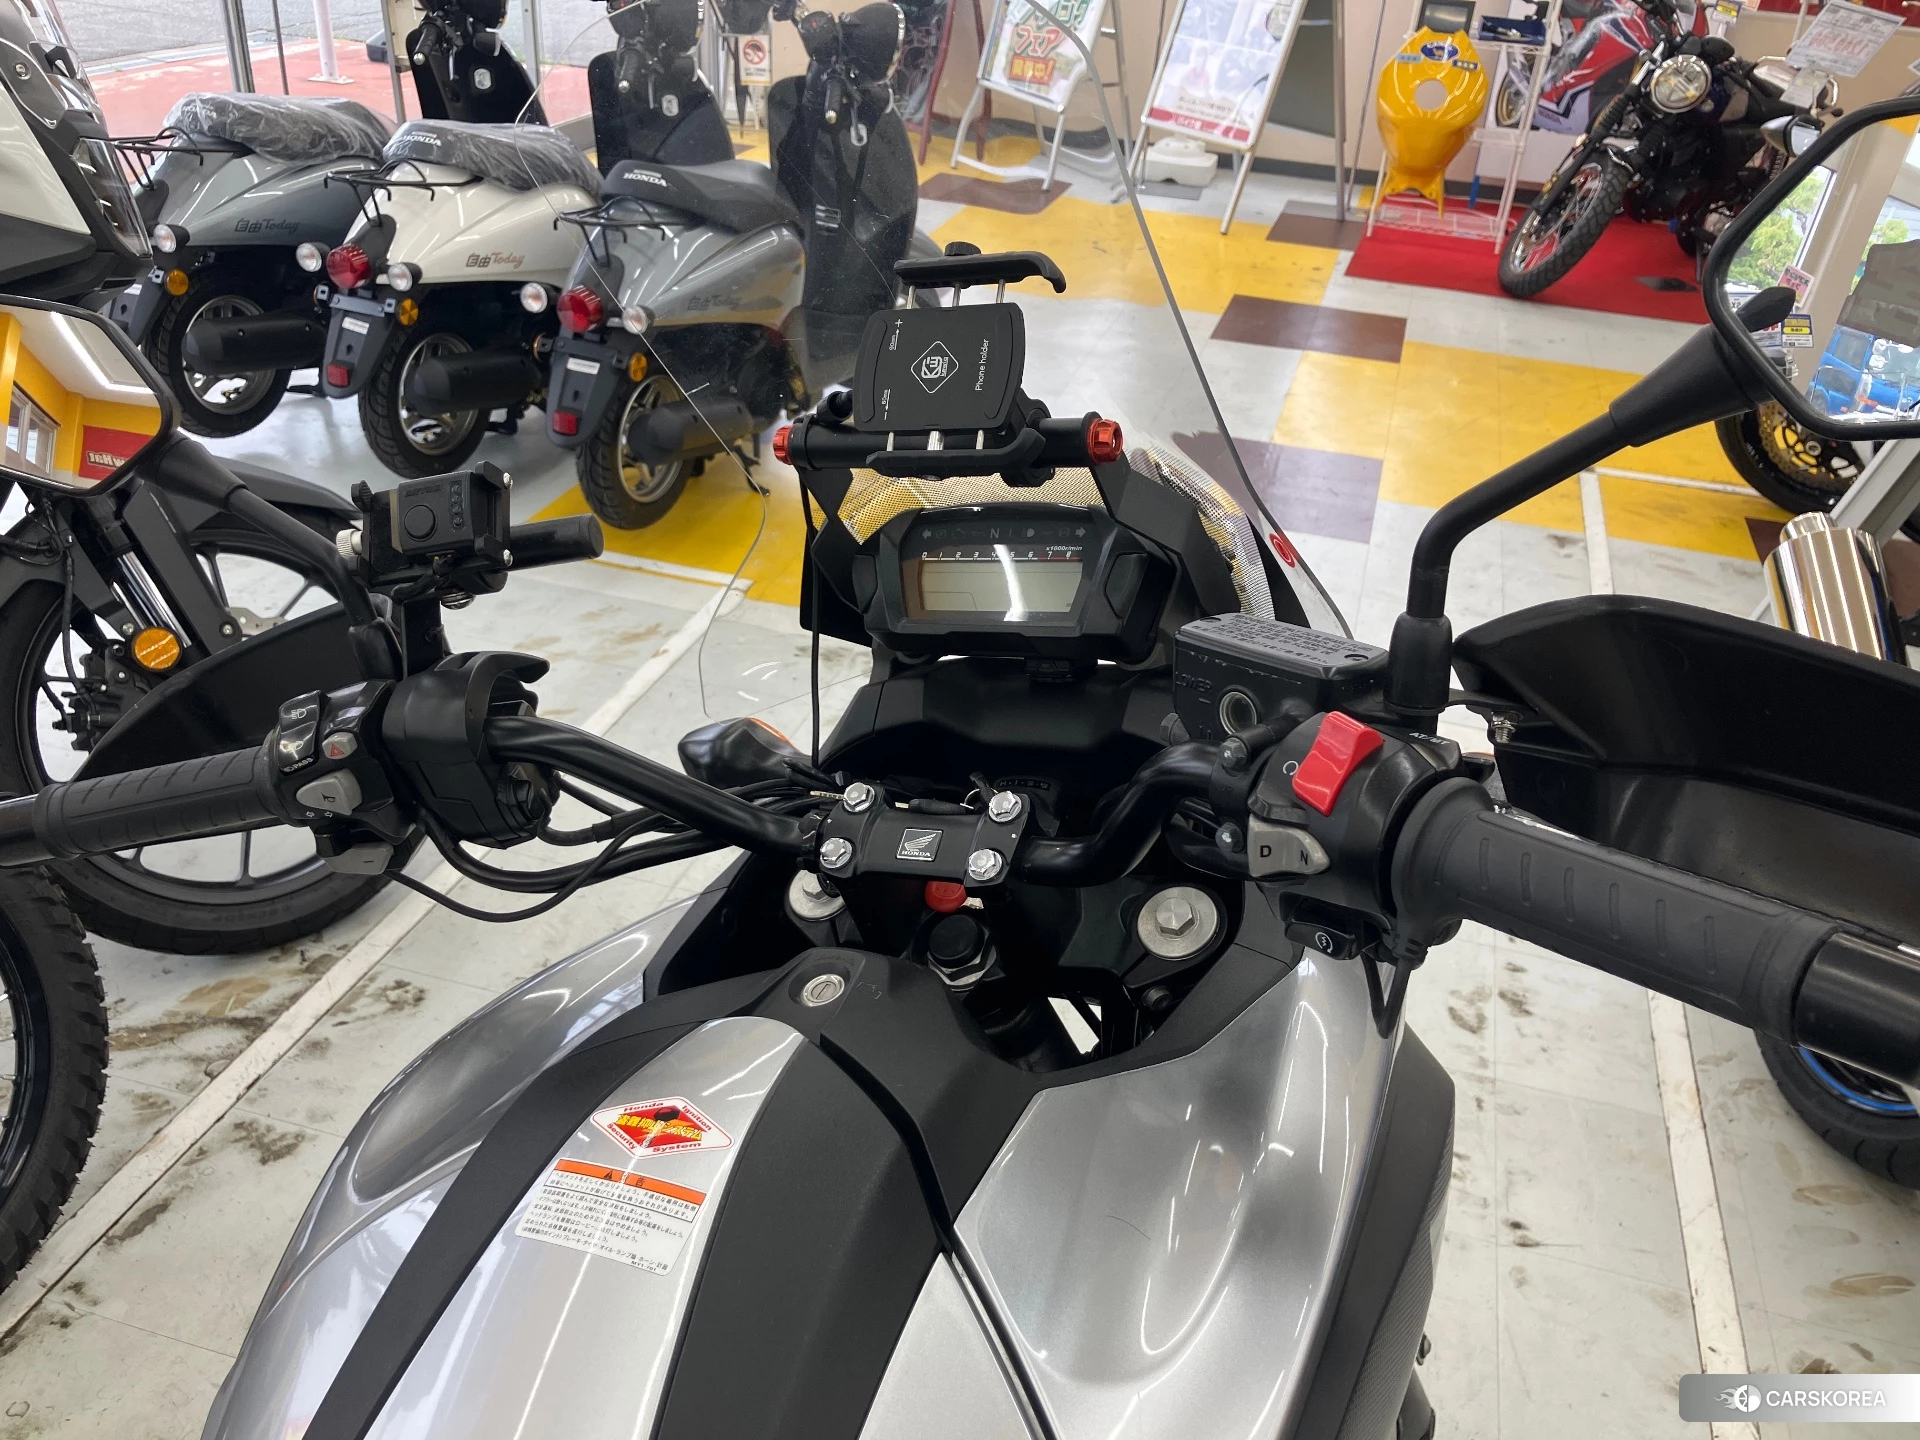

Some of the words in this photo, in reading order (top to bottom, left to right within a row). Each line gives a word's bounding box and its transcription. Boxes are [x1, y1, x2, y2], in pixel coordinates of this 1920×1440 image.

[1014, 25, 1062, 57] フェア
[401, 135, 442, 147] HONDA
[622, 172, 668, 187] HONDA
[978, 338, 990, 364] holder
[974, 365, 986, 391] Phone
[989, 527, 1001, 539] N
[1174, 671, 1213, 692] LOWER
[1408, 731, 1451, 746] AT/MT
[292, 757, 314, 769] PASS
[1259, 844, 1272, 858] D
[1299, 851, 1309, 866] N
[623, 1102, 664, 1113] Honda
[681, 1105, 712, 1131] Ignition
[606, 1123, 638, 1150] Security
[652, 1142, 702, 1153] System
